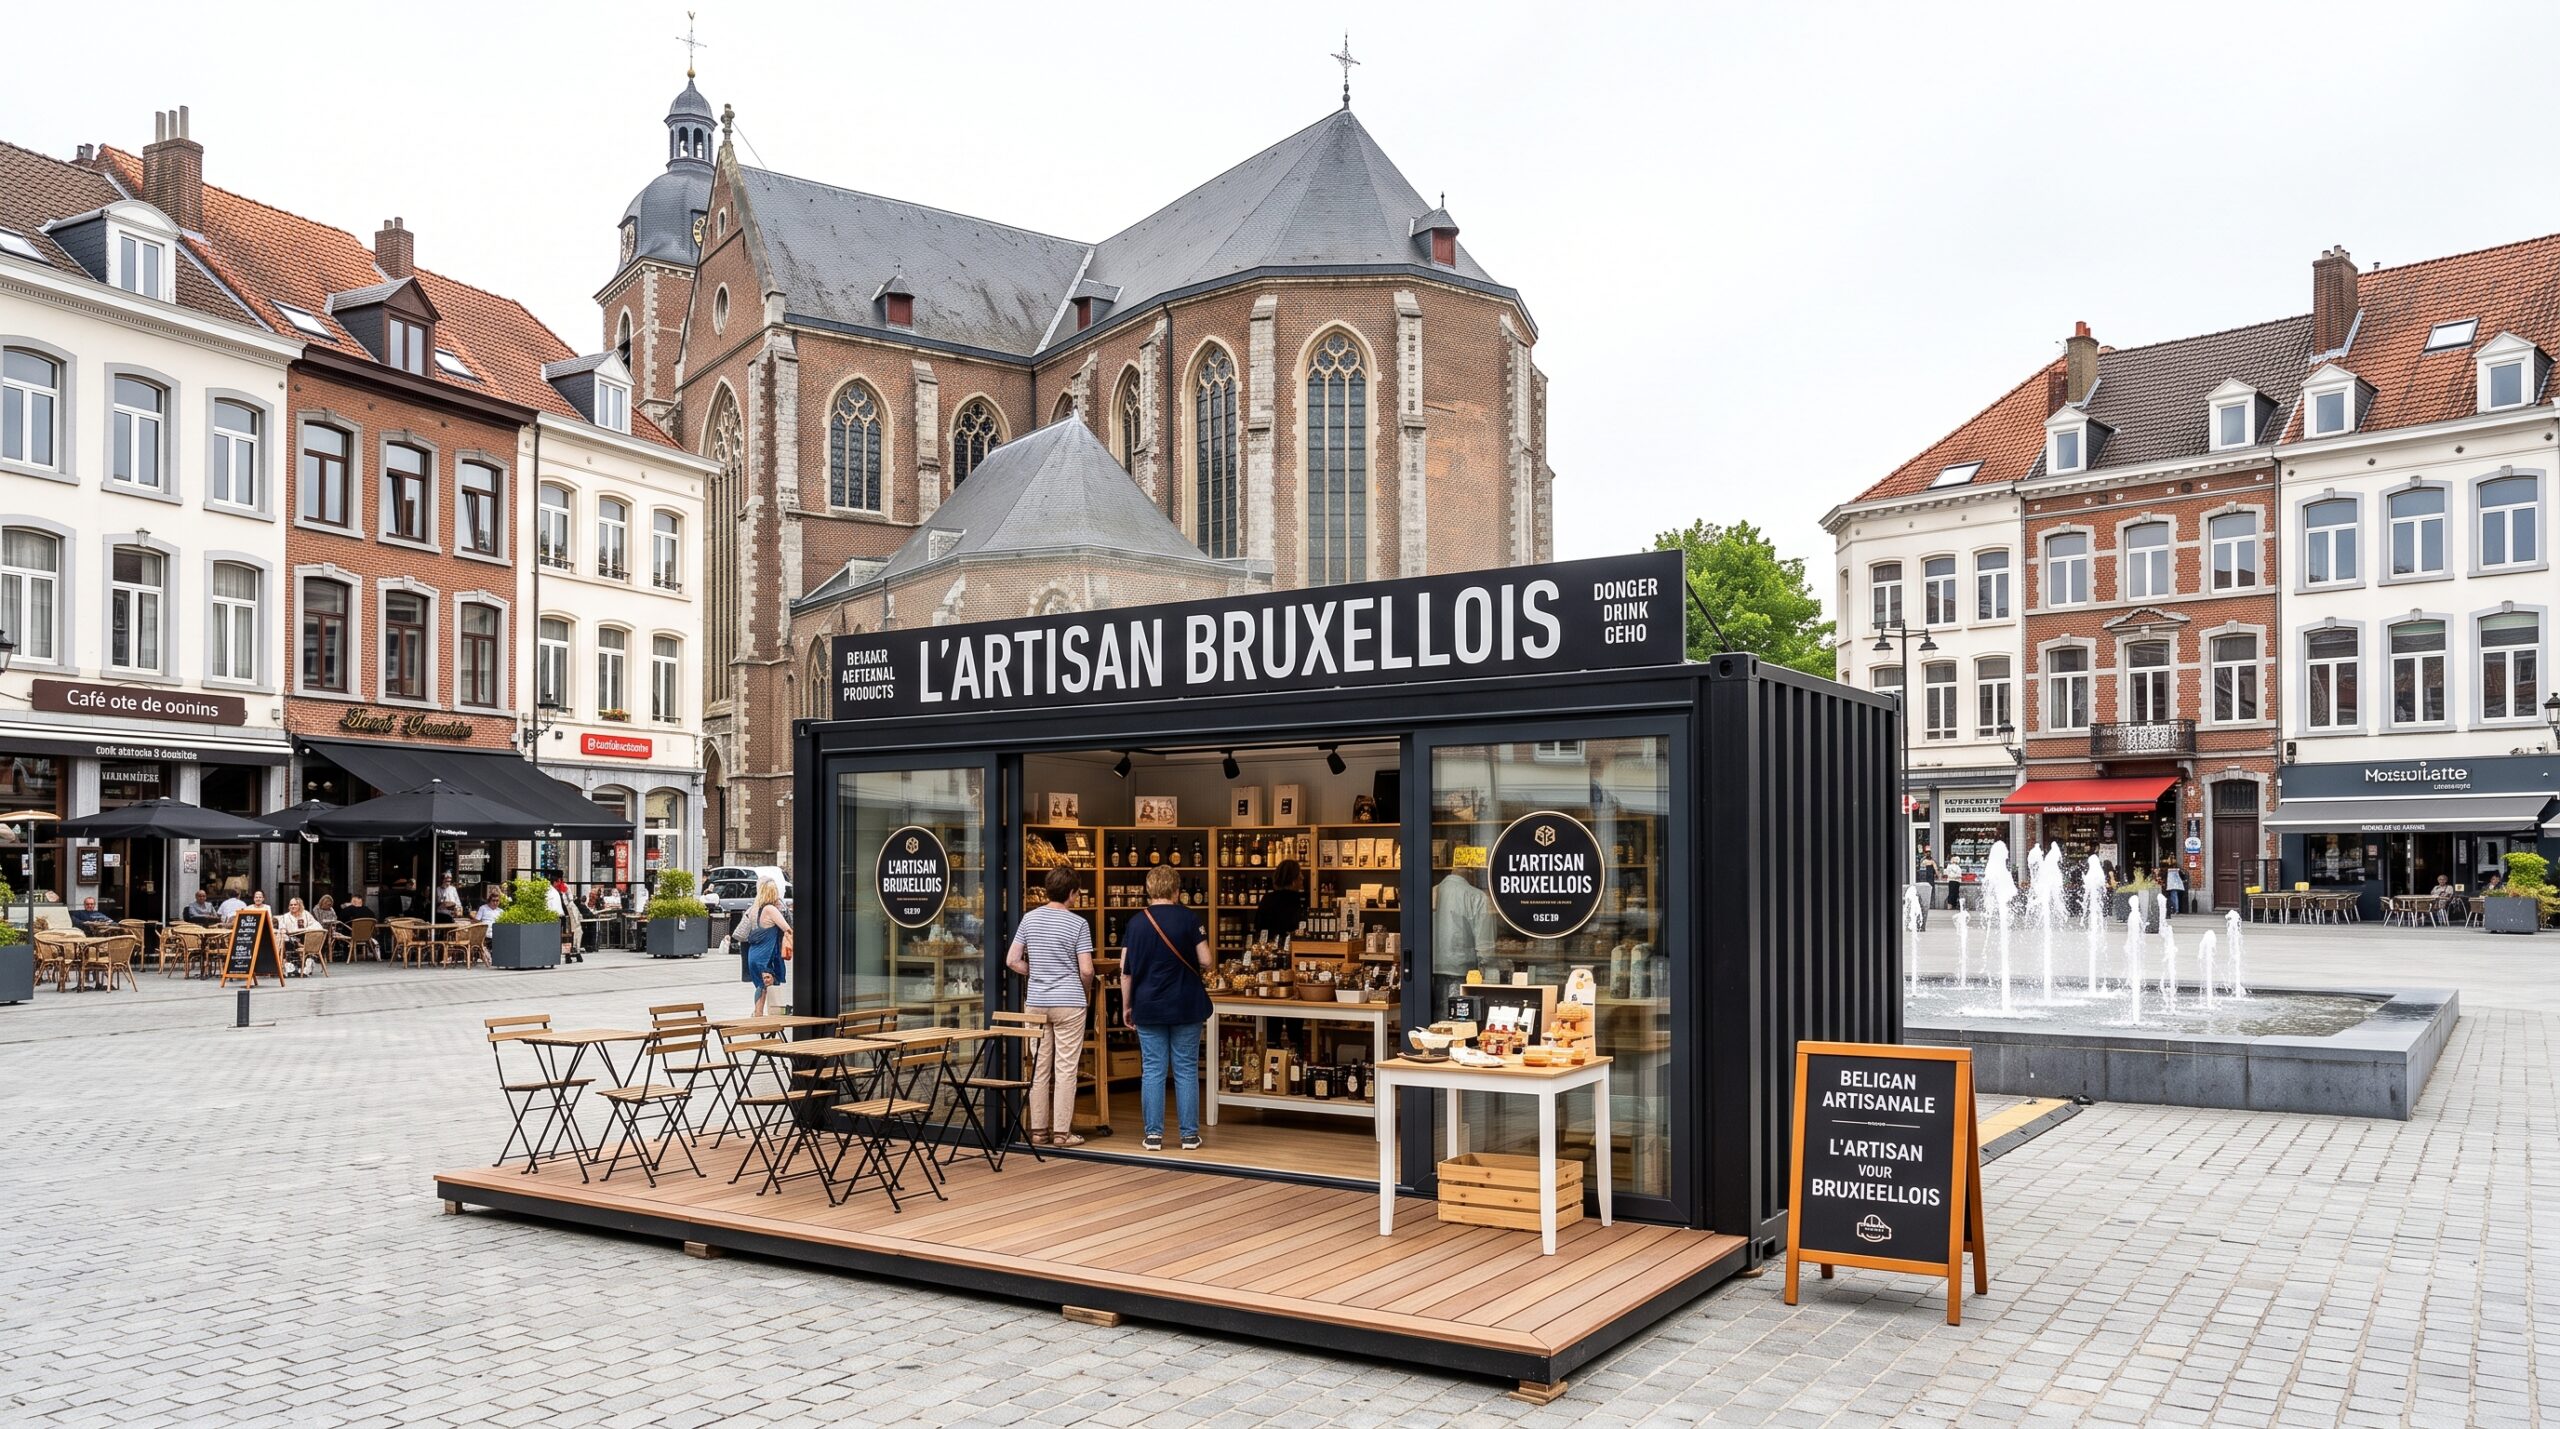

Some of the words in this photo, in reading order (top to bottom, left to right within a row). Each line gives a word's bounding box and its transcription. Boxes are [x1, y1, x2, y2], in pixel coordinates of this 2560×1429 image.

[1593, 577, 1658, 601] DONGER
[1603, 600, 1649, 622] DRINK
[920, 619, 1164, 703] L'ARTISAN
[1186, 579, 1561, 686] BRUXELLOIS
[66, 689, 106, 708] Café
[110, 695, 138, 711] ote
[141, 696, 162, 713] de
[843, 684, 895, 702] PRODUCTS
[888, 859, 937, 875] L'ARTISAN
[1508, 853, 1584, 872] L'ARTISAN
[883, 877, 942, 893] BRUXELLOIS
[1500, 875, 1593, 894] BRUXELLOIS
[1821, 1090, 1936, 1114] ARTISANALE
[1829, 1138, 1924, 1162] L'ARTISAN
[1858, 1163, 1893, 1179] VOUR
[1811, 1178, 1941, 1207] BRUXIEELLOIS
